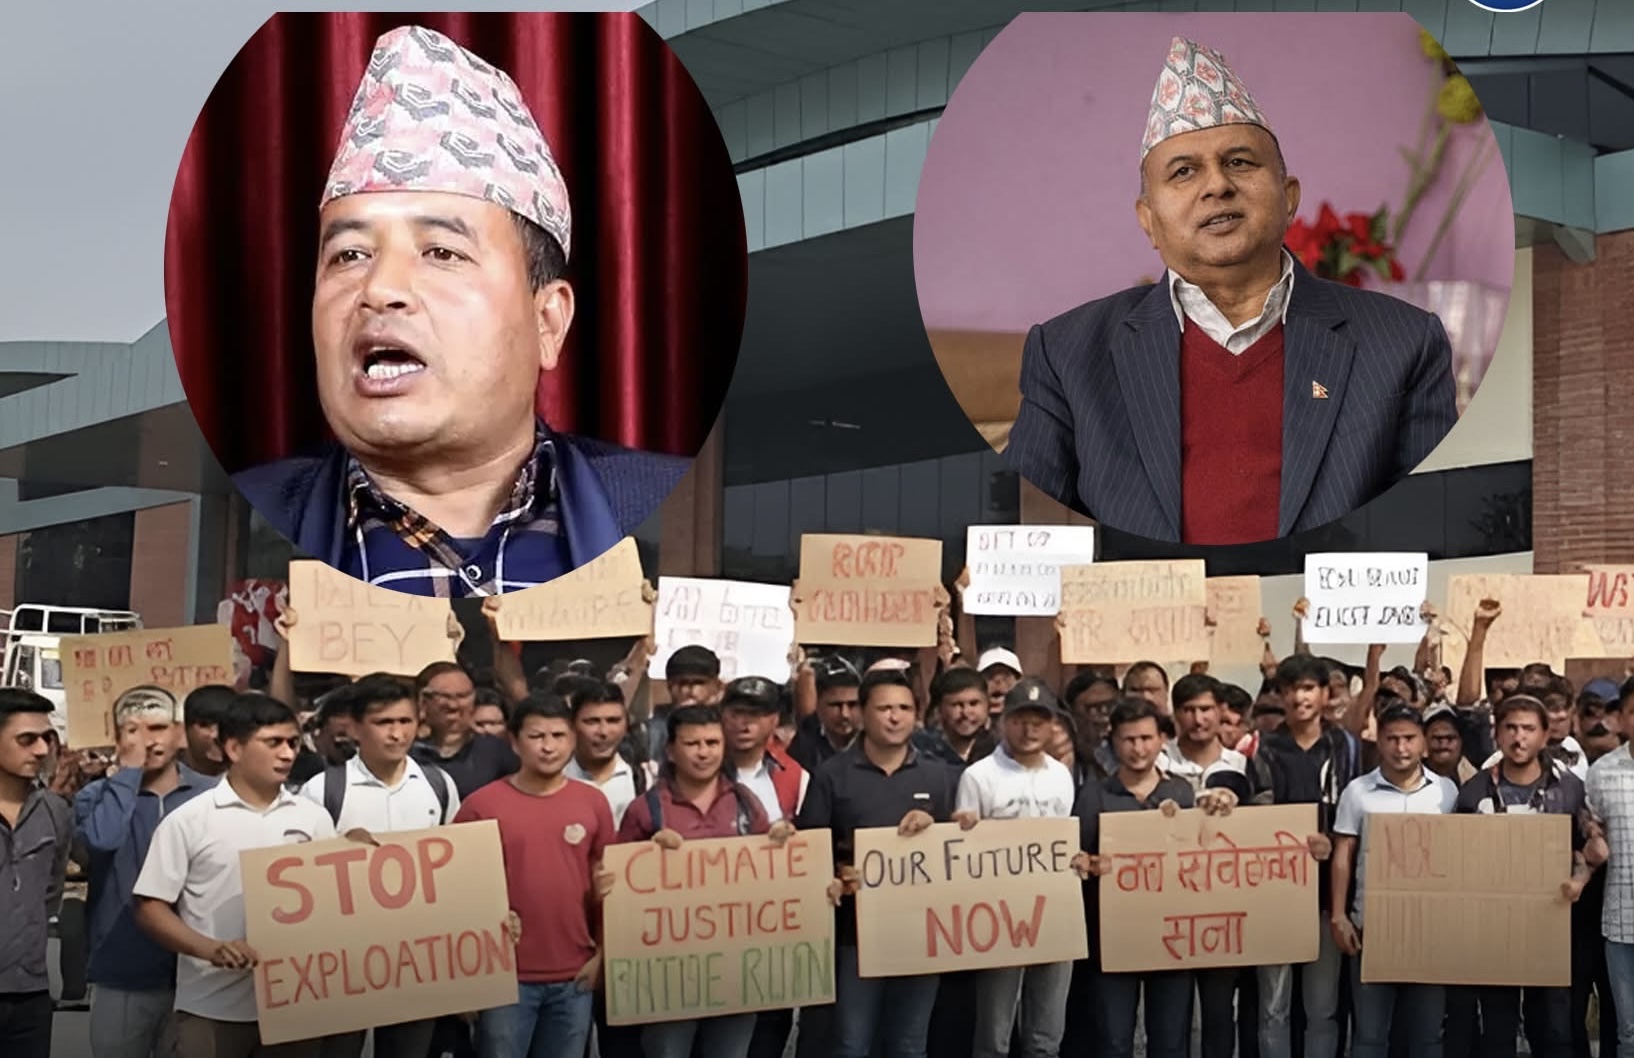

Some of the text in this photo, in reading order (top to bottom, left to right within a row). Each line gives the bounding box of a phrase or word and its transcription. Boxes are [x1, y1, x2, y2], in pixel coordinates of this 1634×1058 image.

[318, 621, 416, 668] BEY
[267, 837, 454, 924] STOP
[625, 841, 809, 894] CLIMATE
[863, 838, 1068, 888] OUR FUTURE
[641, 899, 800, 946] JUSTICE
[926, 895, 1046, 957] NOW
[262, 922, 513, 1009] EXPLOATION
